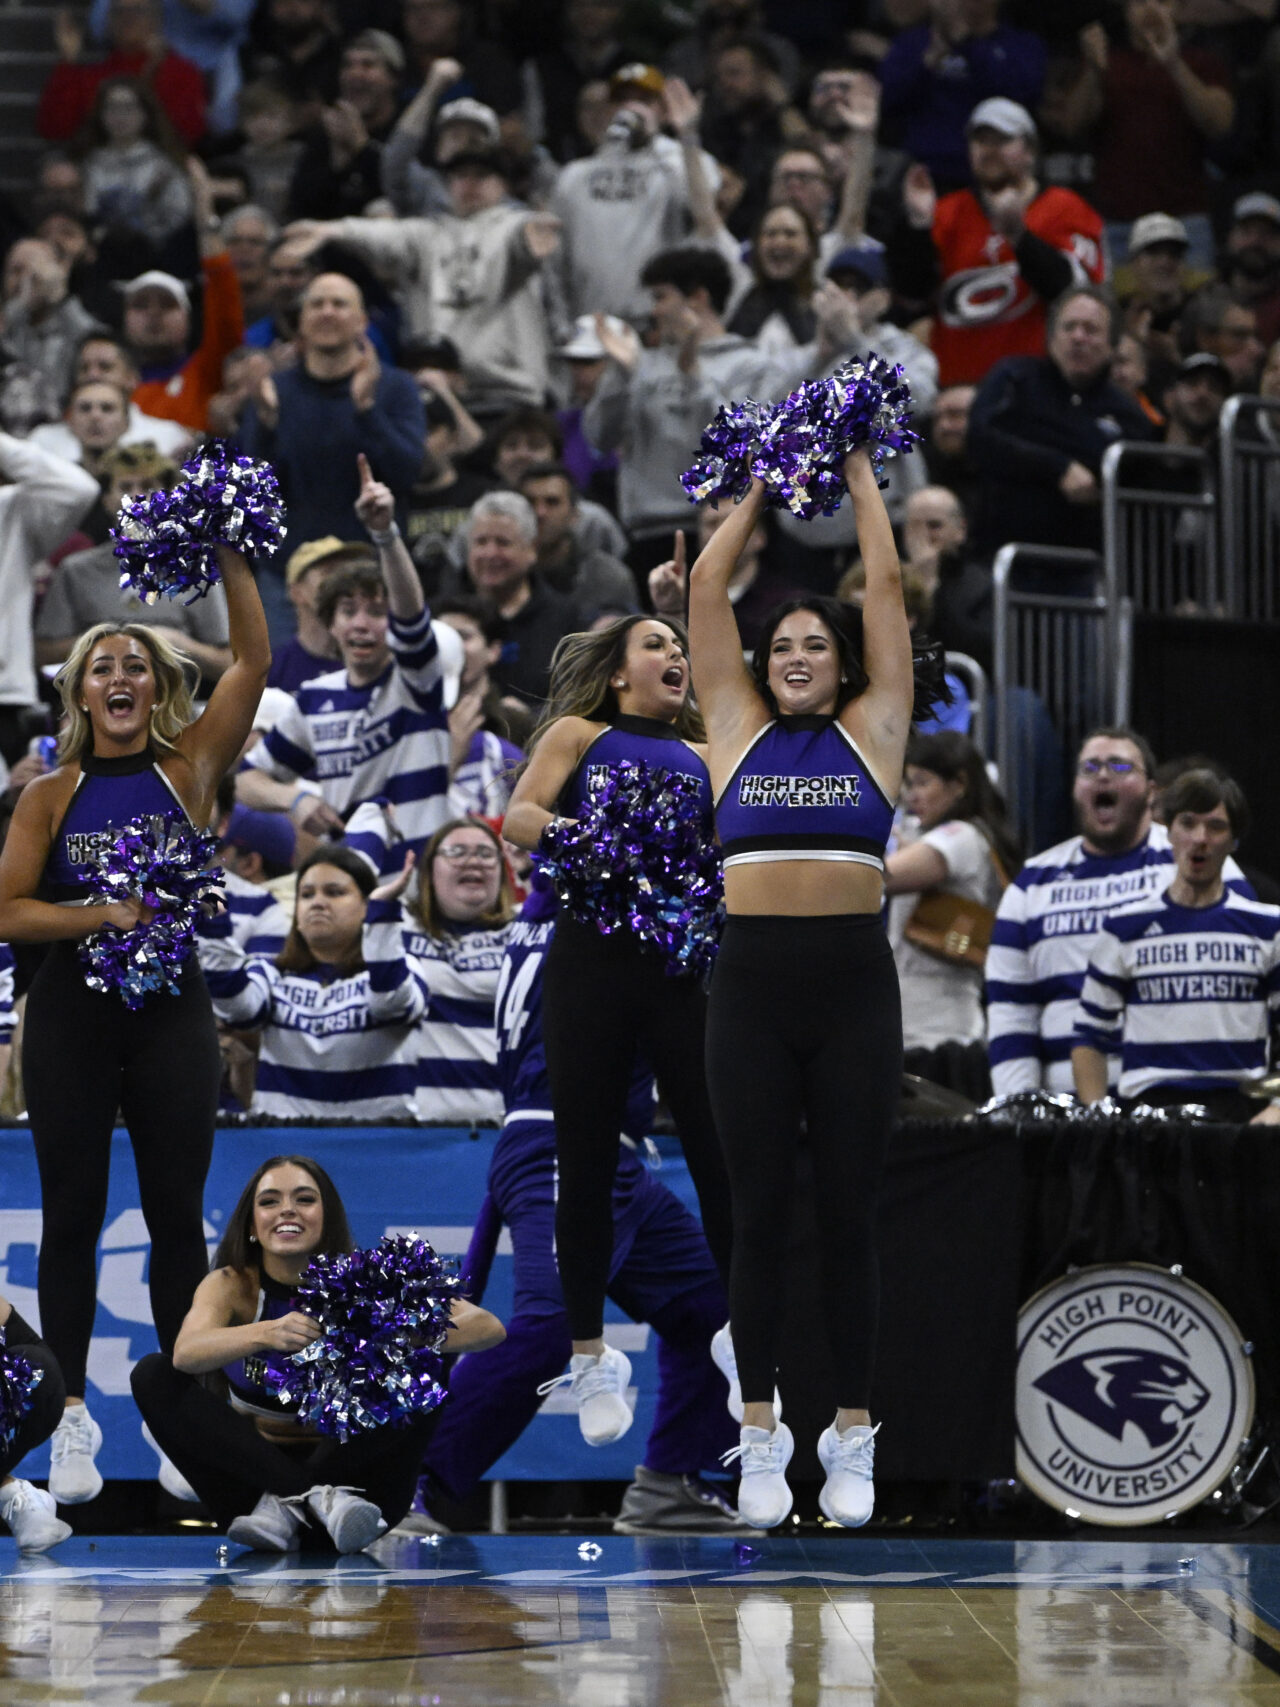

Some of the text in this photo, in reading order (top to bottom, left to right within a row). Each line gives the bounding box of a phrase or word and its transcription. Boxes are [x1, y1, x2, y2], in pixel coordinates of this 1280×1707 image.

[741, 775, 859, 793] HIGH POINT
[739, 791, 861, 807] UNIVERSITY
[1051, 884, 1101, 905] HIGH
[1136, 940, 1261, 966] HIGH POINT
[1039, 1292, 1200, 1349] HIGH POINT
[1047, 1441, 1203, 1498] UNIVERSITY
